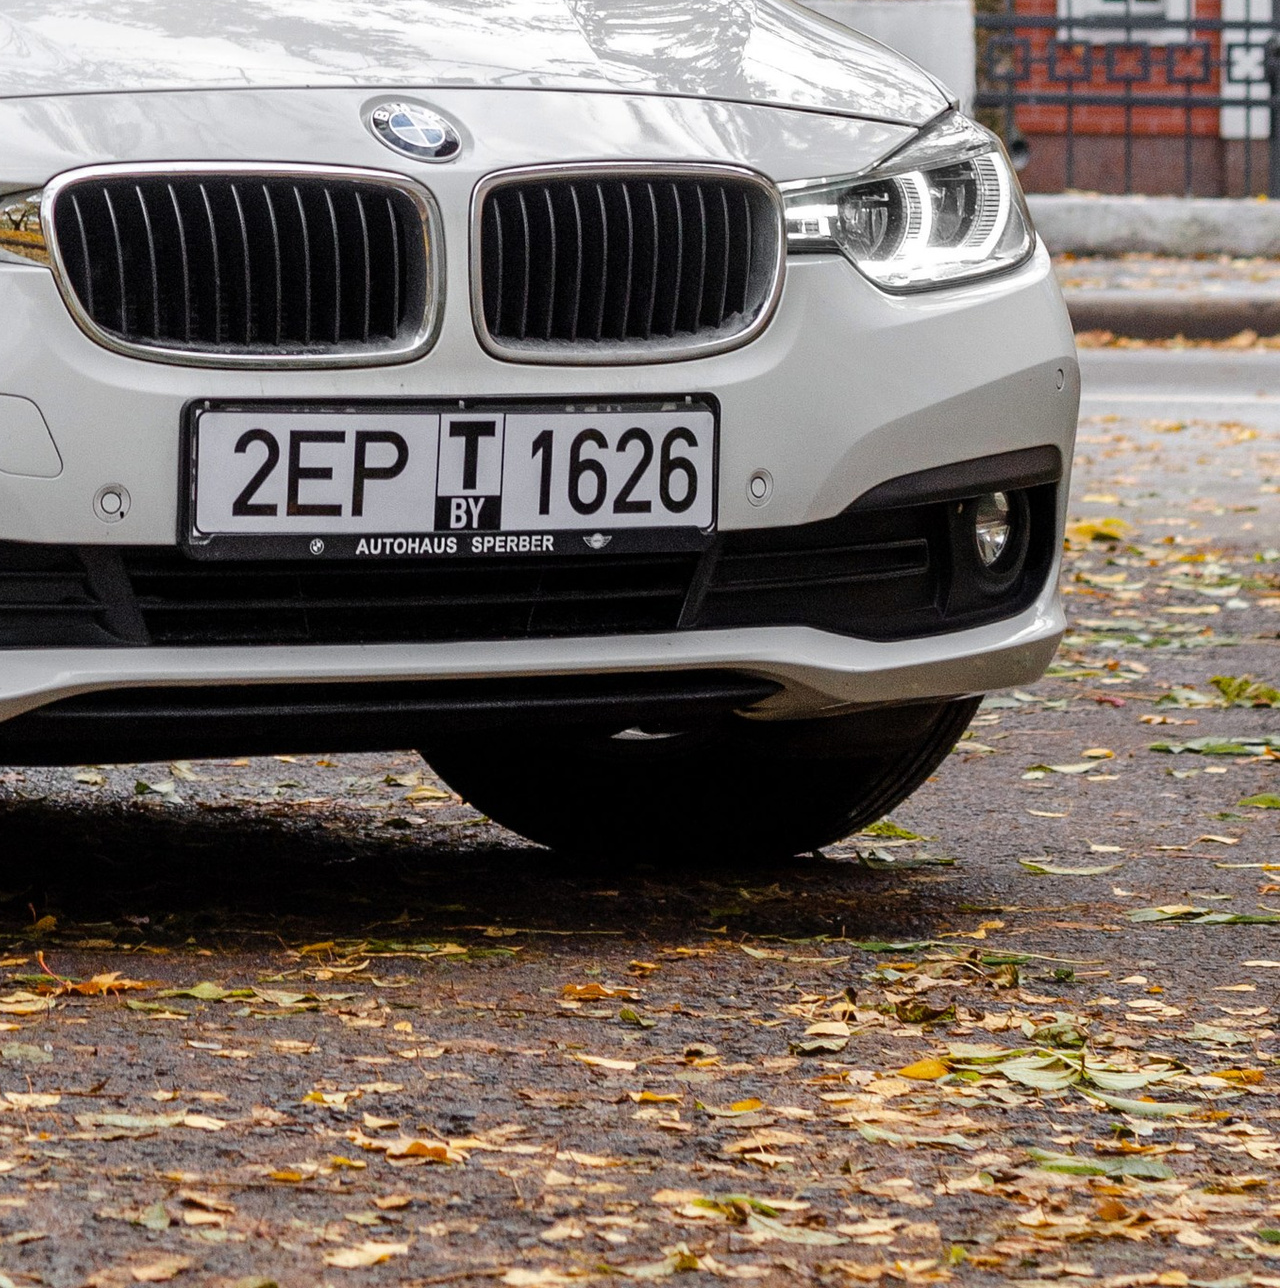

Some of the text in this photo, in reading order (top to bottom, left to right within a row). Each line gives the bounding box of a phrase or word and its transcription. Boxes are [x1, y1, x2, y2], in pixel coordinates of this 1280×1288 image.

[232, 420, 699, 517] 2EP T 1626
[449, 497, 485, 529] BY
[355, 534, 554, 555] AUTOHAUS SPERBER
